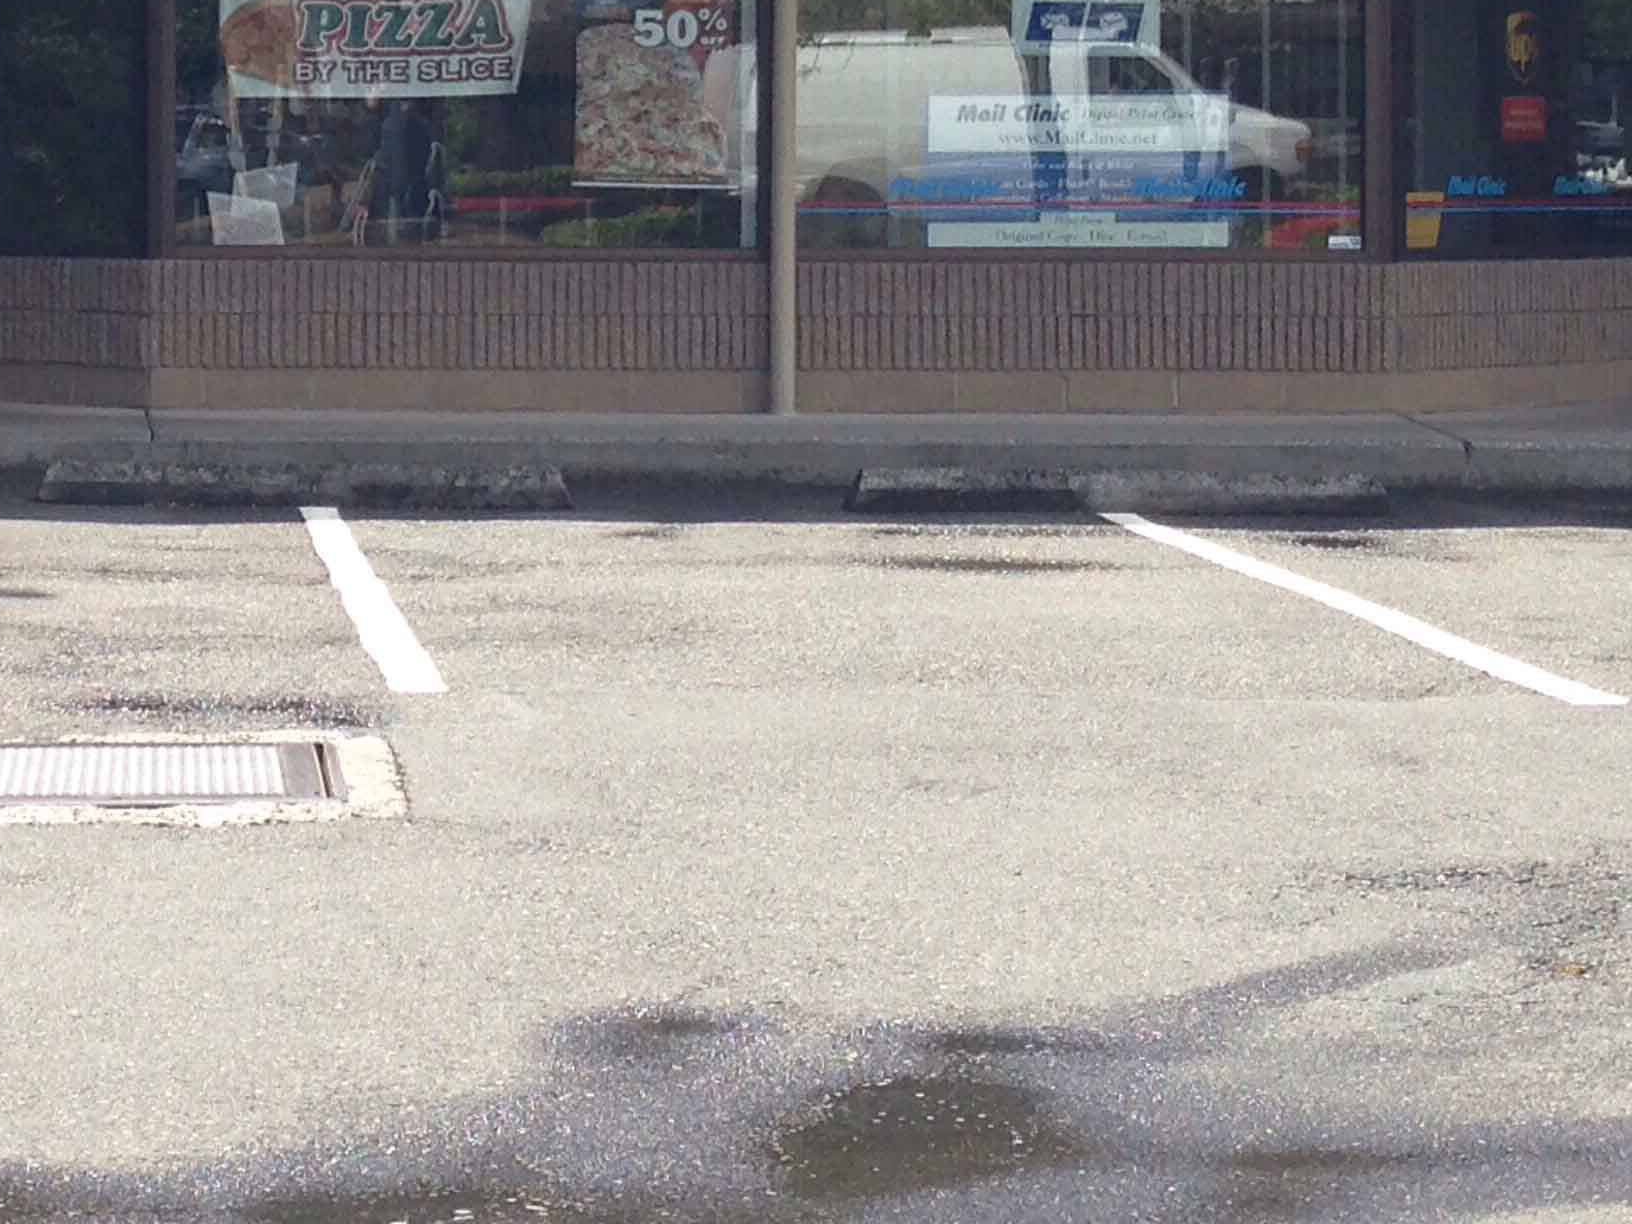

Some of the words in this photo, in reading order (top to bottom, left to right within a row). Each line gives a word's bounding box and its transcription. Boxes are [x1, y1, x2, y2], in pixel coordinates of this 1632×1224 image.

[296, 61, 336, 83] BY
[342, 60, 409, 84] THE
[418, 58, 514, 81] SLICE
[956, 103, 1006, 123] Mail
[1013, 101, 1071, 123] Clinic
